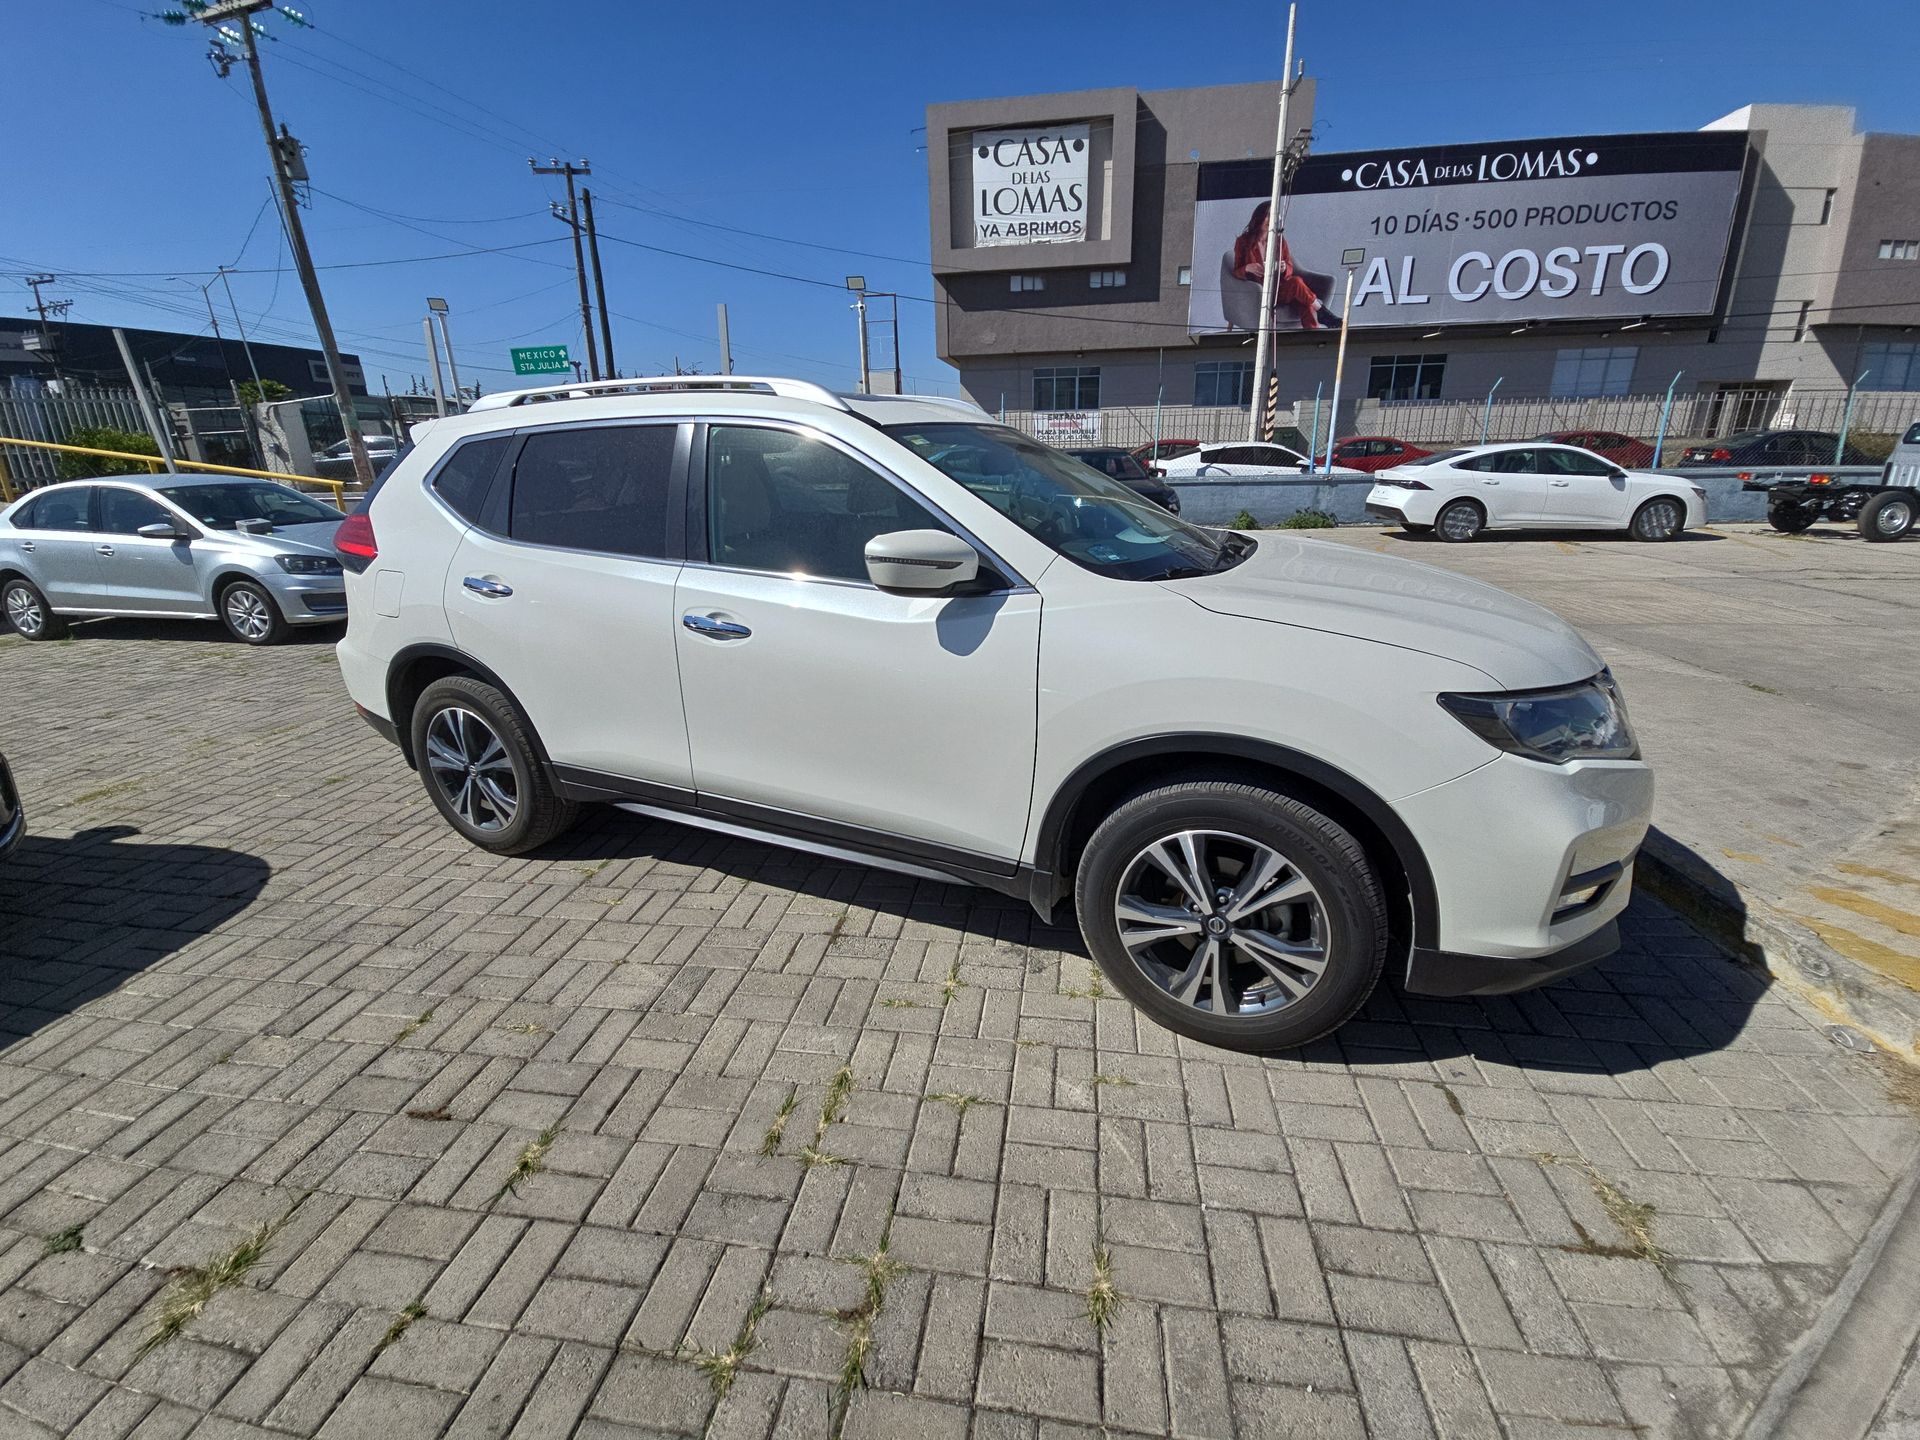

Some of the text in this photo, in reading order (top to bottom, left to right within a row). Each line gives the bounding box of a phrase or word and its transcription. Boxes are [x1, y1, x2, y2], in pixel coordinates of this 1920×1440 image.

[993, 135, 1071, 167] CASA
[1355, 159, 1430, 189] CASA
[1477, 148, 1582, 181] LOMAS
[982, 183, 1082, 216] LOMAS
[980, 220, 1082, 238] YA ABRIMOS
[1370, 215, 1398, 236] 10
[1404, 208, 1460, 234] DÍAS
[1524, 200, 1679, 228] PRODUCTOS
[1352, 242, 1671, 307] AL COSTO
[519, 350, 556, 360] MEXICO
[520, 361, 561, 371] STA JULIA
[1048, 412, 1087, 421] ENTRADA
